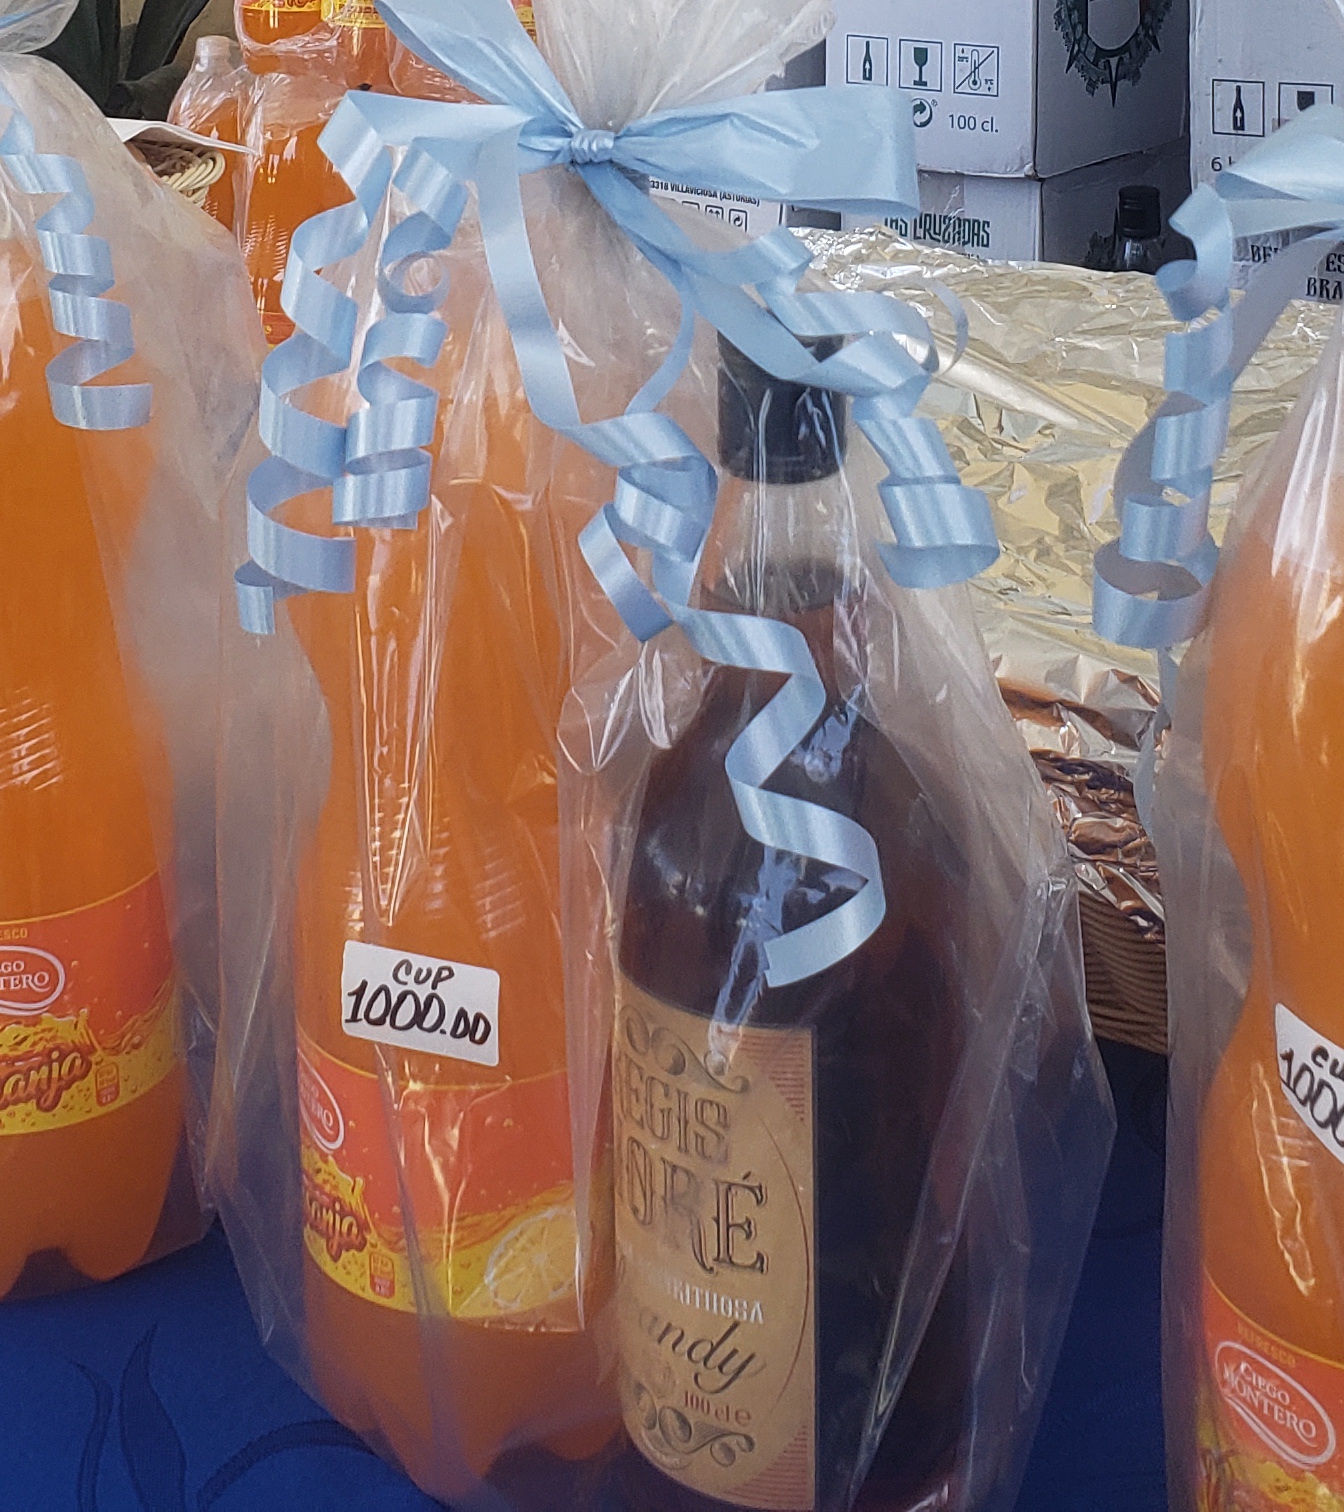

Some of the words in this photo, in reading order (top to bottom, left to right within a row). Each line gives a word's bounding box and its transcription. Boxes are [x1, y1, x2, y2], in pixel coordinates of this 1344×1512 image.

[949, 114, 977, 131] 100
[981, 117, 999, 133] cl.
[1211, 157, 1223, 172] 6
[913, 213, 991, 248] CRUZADAS
[392, 959, 455, 990] CUP
[344, 979, 492, 1045] 1000.00
[1240, 1360, 1291, 1407] CIEGO
[1222, 1361, 1319, 1448] MONTERO
